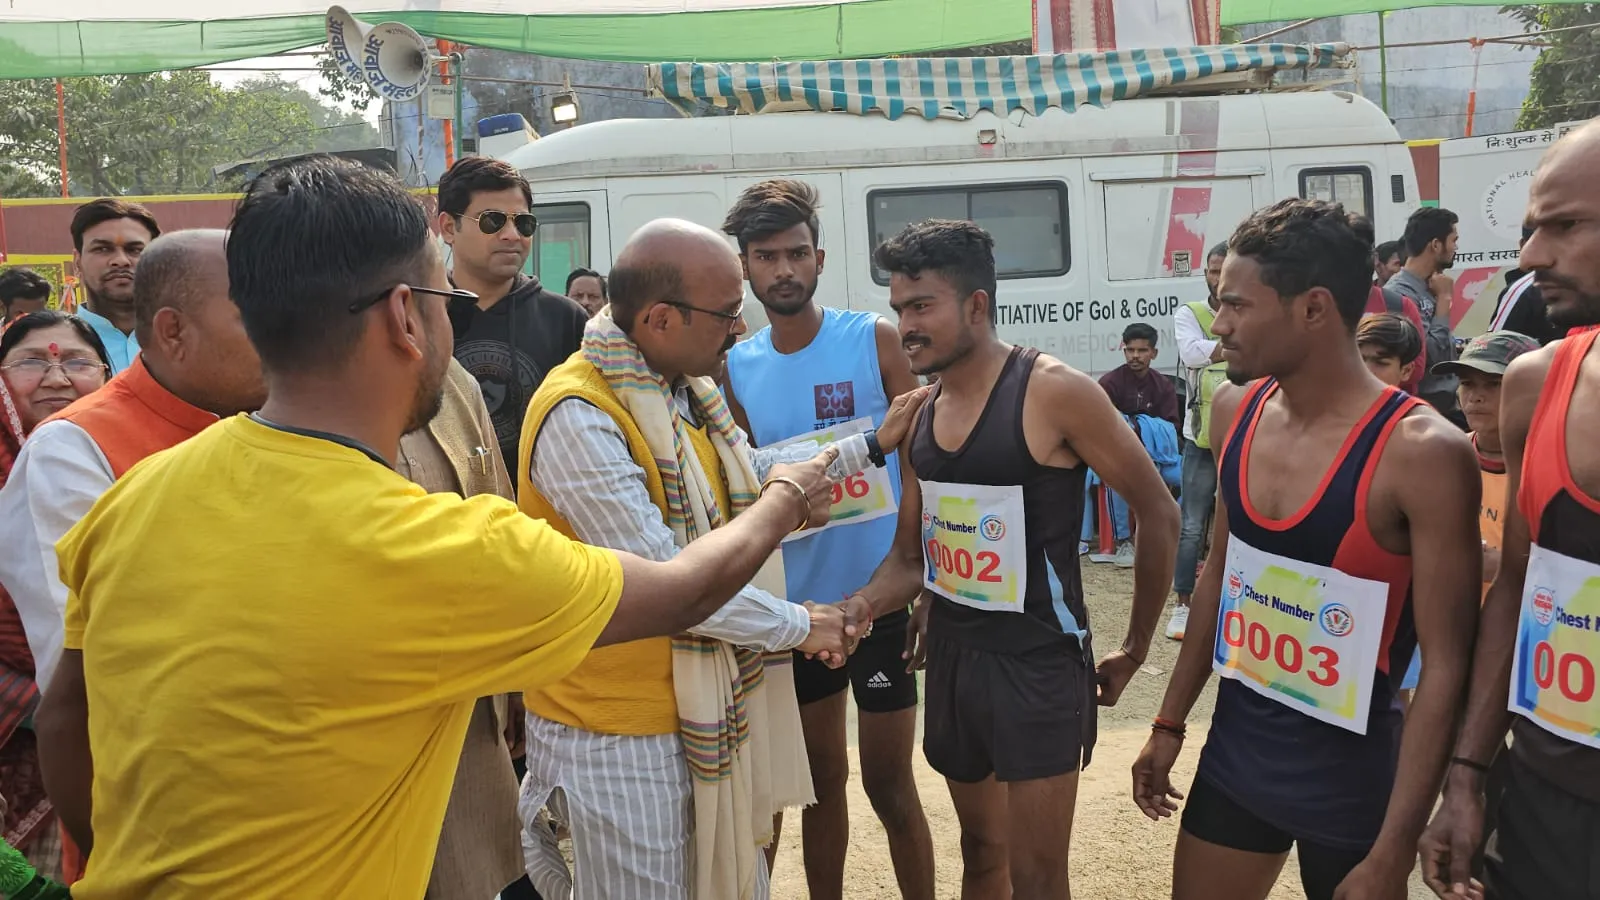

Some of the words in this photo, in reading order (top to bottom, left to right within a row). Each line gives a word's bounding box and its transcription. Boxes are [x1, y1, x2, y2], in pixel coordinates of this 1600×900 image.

[329, 16, 352, 65] आवाज
[346, 63, 363, 81] मह
[364, 34, 389, 87] आवाज
[383, 83, 418, 99] महल
[1487, 180, 1506, 227] NATIONAL
[1509, 170, 1535, 180] HEAL
[1488, 249, 1521, 260] सरक
[995, 303, 1058, 325] ITIATIVE
[1063, 301, 1084, 322] OF
[1120, 299, 1131, 318] &
[1136, 296, 1179, 317] GoUP
[831, 471, 870, 504] 96
[946, 520, 977, 533] Number
[927, 538, 1003, 583] 0002
[1244, 584, 1269, 606] Chest
[1272, 596, 1315, 621] Number
[1556, 606, 1591, 630] Chest
[1223, 610, 1340, 687] 0003
[1533, 641, 1595, 703] 00
